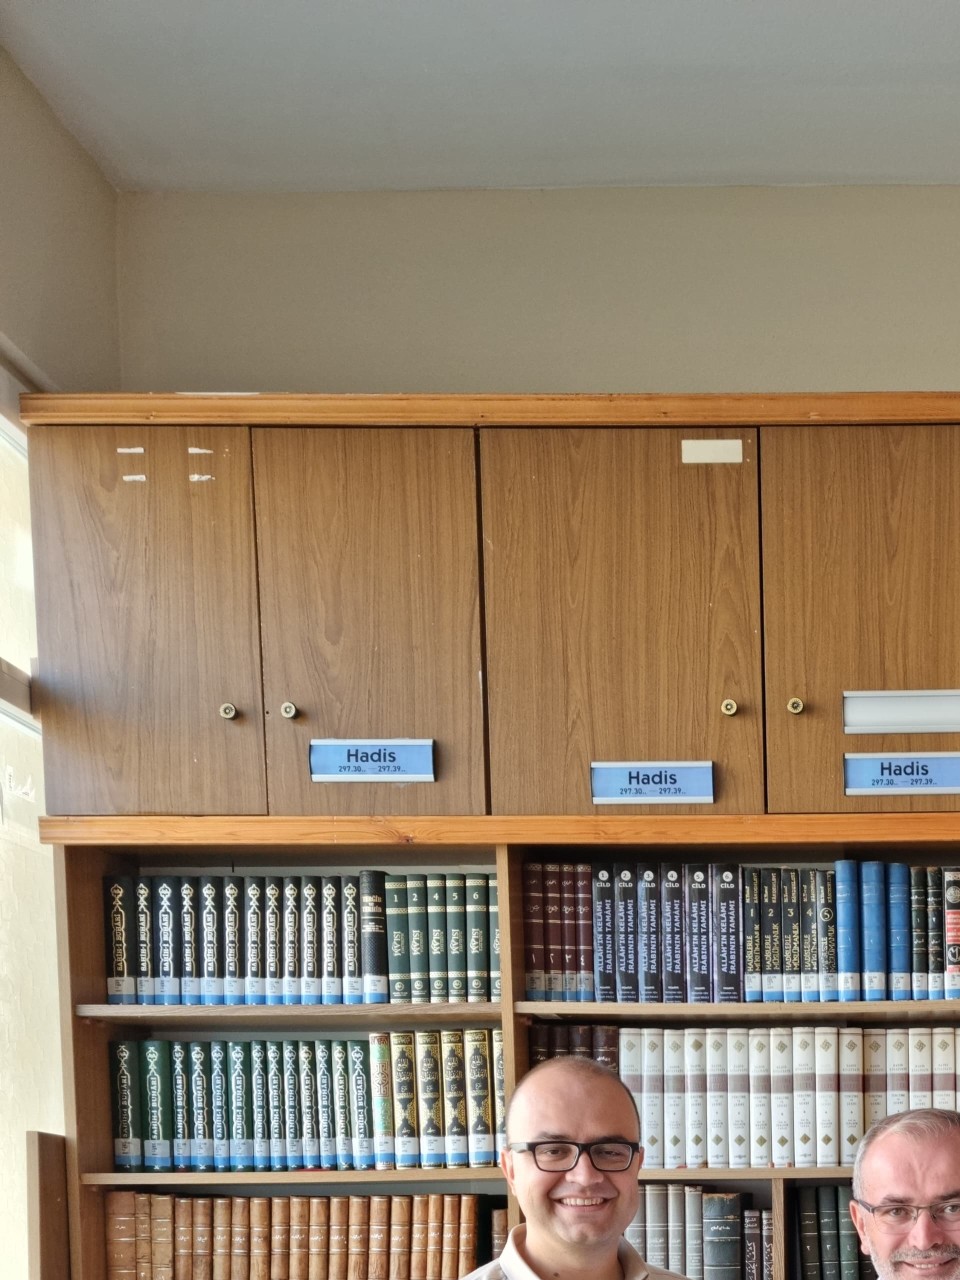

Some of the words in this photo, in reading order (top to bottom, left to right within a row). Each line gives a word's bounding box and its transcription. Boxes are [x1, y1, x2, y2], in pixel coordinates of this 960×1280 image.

[347, 748, 396, 762] Hadis
[881, 761, 929, 776] Hadis
[629, 771, 677, 785] Hadis
[412, 893, 418, 901] 2
[433, 892, 440, 900] 4
[452, 892, 458, 900] 5
[473, 892, 479, 900] 6
[751, 908, 754, 917] 1
[768, 908, 773, 917] 2
[788, 908, 794, 917] 3
[807, 909, 813, 917] 4
[824, 909, 831, 920] 5
